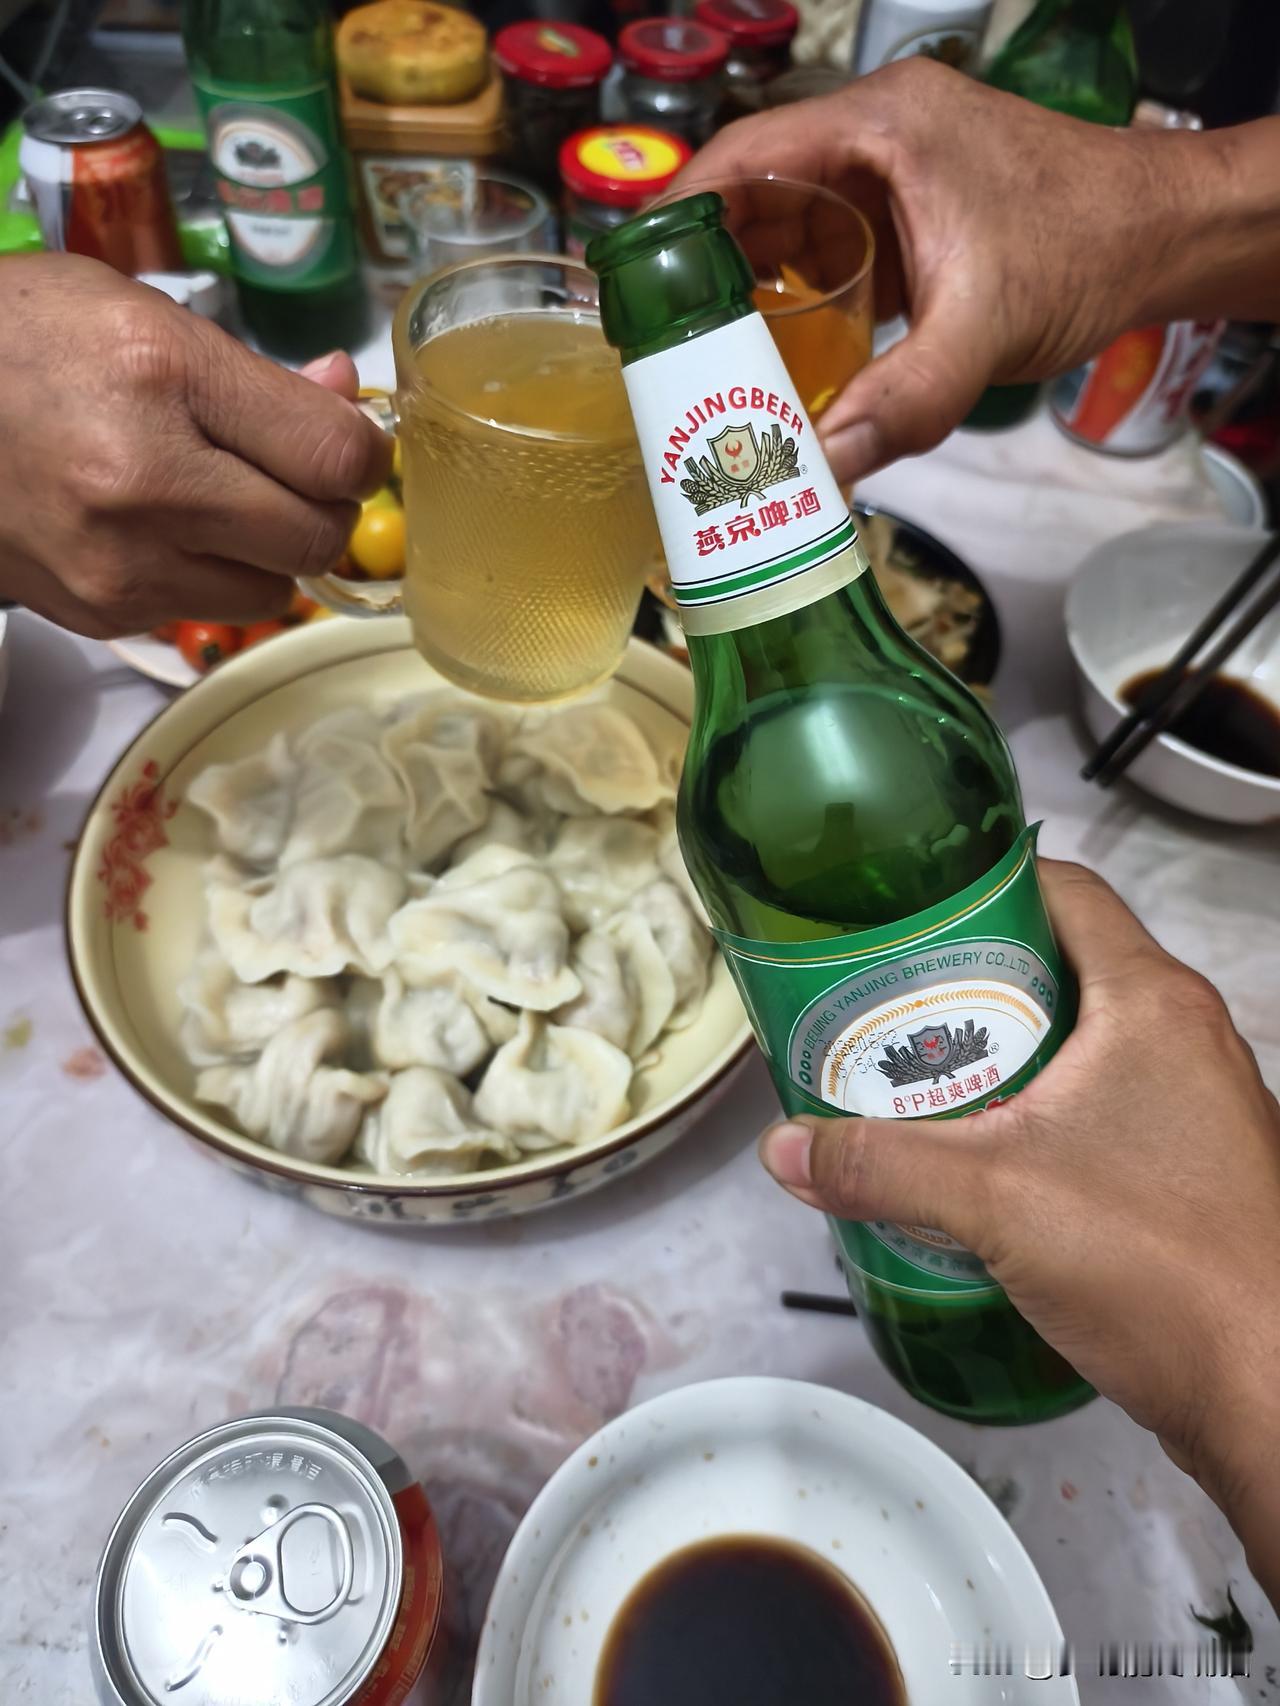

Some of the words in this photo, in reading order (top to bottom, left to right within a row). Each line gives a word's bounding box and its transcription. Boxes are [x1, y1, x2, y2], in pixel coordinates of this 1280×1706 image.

[693, 486, 822, 557] 燕京啤酒
[804, 1009, 837, 1050] BEIJING
[833, 972, 898, 1011] YANJING
[902, 951, 982, 980] BREWERY
